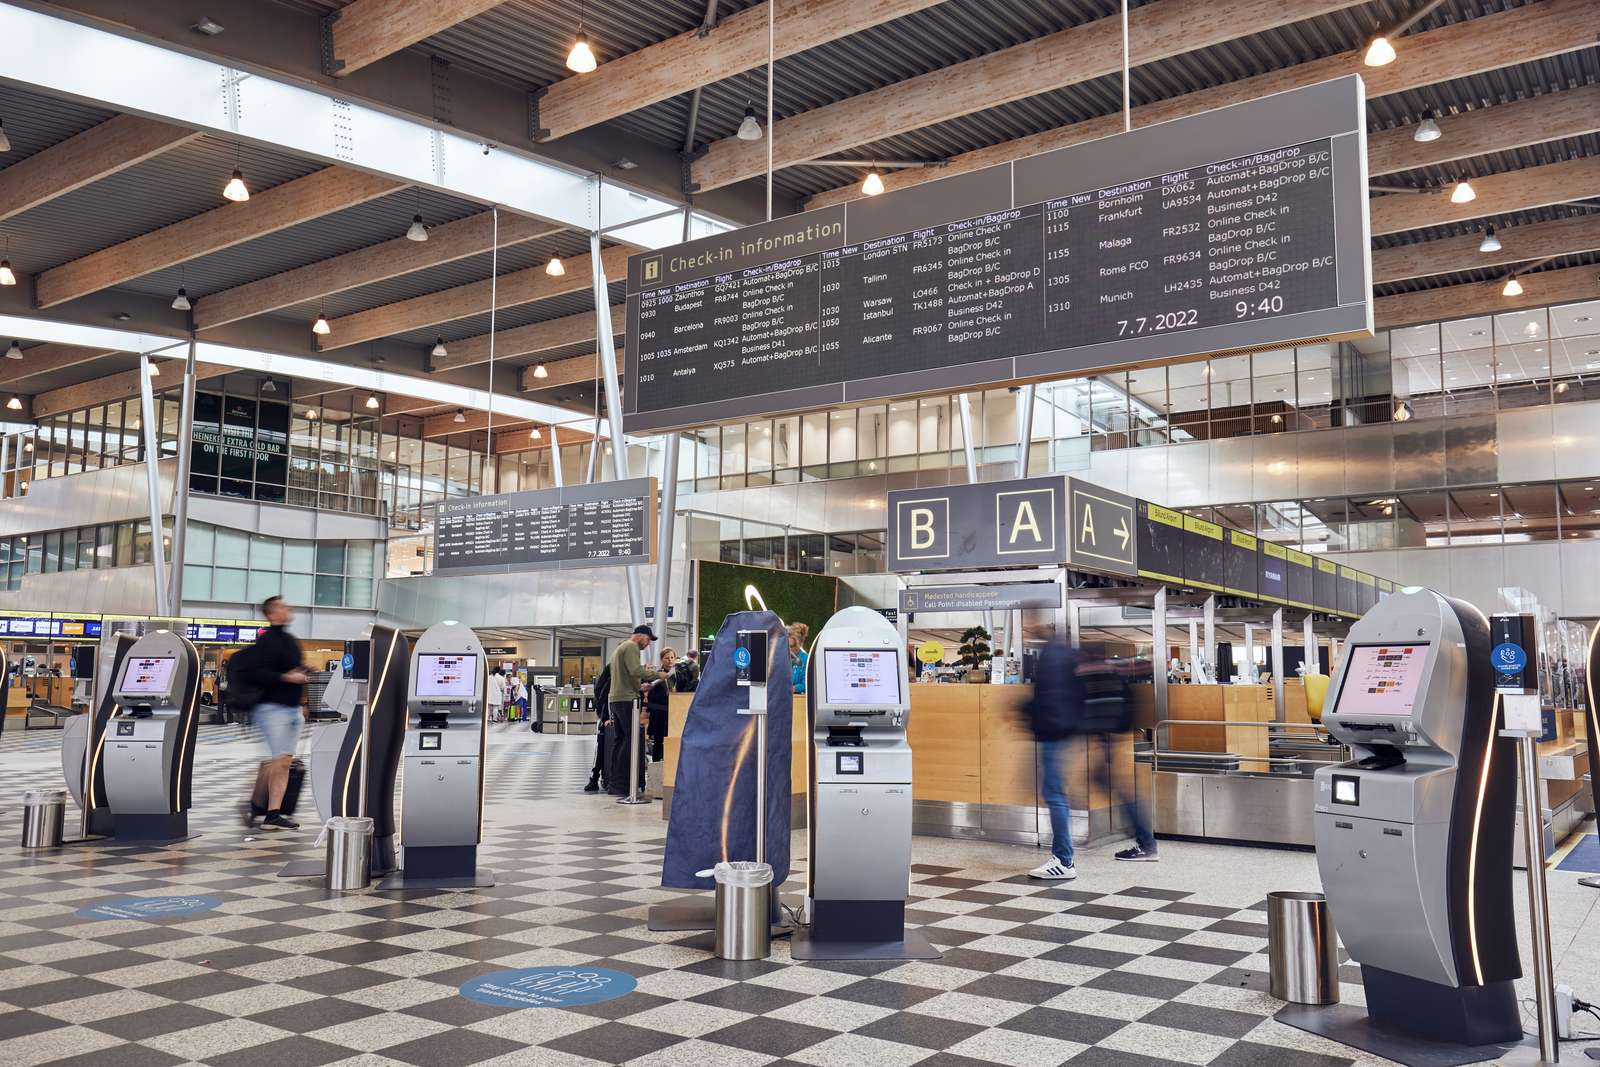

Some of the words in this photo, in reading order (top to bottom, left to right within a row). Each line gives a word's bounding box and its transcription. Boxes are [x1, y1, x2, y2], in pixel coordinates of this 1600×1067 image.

[1046, 199, 1068, 209] Time
[1072, 193, 1091, 204] New
[1098, 180, 1151, 198] Destination
[1162, 172, 1189, 185] Flight
[1206, 147, 1300, 174] Check-in/Bagdrop
[1047, 209, 1069, 220] 1100
[1098, 193, 1143, 209] Bornholm
[1162, 182, 1195, 196] DX062
[1207, 158, 1305, 186] Automat+BagDrop
[1309, 152, 1329, 165] B/C
[1047, 223, 1069, 234] 1115
[1099, 207, 1143, 223] Frankfurt
[1162, 194, 1201, 209] UA9534
[1207, 172, 1306, 200] Automat+BagDrop
[1310, 167, 1330, 179] B/C
[1207, 198, 1252, 214] Business
[1256, 192, 1278, 205] D42
[670, 248, 733, 272] Check-in
[741, 221, 841, 256] information
[822, 250, 839, 259] Time
[842, 246, 858, 255] New
[864, 235, 905, 250] Destination
[913, 229, 934, 240] Flight
[948, 210, 1020, 232] Check-in/Bagdrop
[823, 260, 840, 269] 1015
[864, 248, 890, 260] London
[893, 244, 908, 254] STN
[913, 237, 943, 249] FR5173
[948, 231, 973, 242] Online
[976, 226, 1000, 236] Check
[948, 240, 982, 254] BagDrop
[985, 237, 1000, 248] B/C
[1048, 249, 1070, 260] 1155
[1099, 236, 1132, 251] Malaga
[1163, 223, 1200, 237] FR2532
[1208, 215, 1241, 228] Online
[1244, 209, 1277, 222] Check
[1280, 205, 1289, 215] in
[1208, 227, 1254, 243] BagDrop
[1256, 222, 1276, 234] B/C
[675, 279, 709, 292] Destination
[715, 274, 732, 283] Flight
[743, 258, 802, 277] Check-in/Bagdrop
[822, 283, 840, 293] 1030
[864, 273, 887, 284] Tallinn
[913, 261, 943, 274] FR6345
[948, 256, 973, 267] Online
[976, 251, 1001, 261] Check
[948, 266, 982, 279] BagDrop
[985, 262, 1000, 273] B/C
[1048, 274, 1070, 286] 1305
[1100, 265, 1126, 276] Rome
[1129, 260, 1149, 272] FCO
[1163, 251, 1201, 265] FR9634
[1209, 243, 1241, 257] Online
[1245, 238, 1278, 251] Check
[1281, 234, 1290, 243] in
[1209, 256, 1254, 272] BagDrop
[1257, 251, 1277, 264] B/C
[641, 300, 656, 308] 0925
[743, 267, 804, 286] Automat+BagDrop
[806, 263, 819, 273] B/C
[641, 310, 656, 319] 0930
[675, 300, 703, 312] Budapest
[714, 292, 739, 303] FR8744
[743, 288, 763, 298] Online
[765, 284, 786, 292] Check
[822, 307, 840, 316] 1030
[864, 297, 892, 308] Warsaw
[913, 287, 938, 298] LO466
[948, 281, 973, 292] Check
[995, 271, 1031, 284] BagDrop
[1048, 301, 1070, 313] 1310
[1100, 291, 1133, 304] Munich
[1164, 279, 1202, 293] LH2435
[1209, 262, 1309, 286] Automat+BagDrop
[1312, 255, 1333, 267] B/C
[1210, 285, 1255, 299] Business
[1259, 280, 1280, 292] D42
[641, 331, 655, 340] 0940
[674, 322, 704, 333] Barcelona
[714, 315, 738, 325] FR9003
[743, 310, 763, 320] Online
[765, 306, 785, 316] Check
[822, 318, 840, 328] 1050
[864, 308, 894, 320] Istanbul
[913, 299, 942, 311] TK1488
[948, 286, 1024, 305] Automat+BagDrop
[948, 305, 983, 317] Business
[986, 301, 1003, 311] D42
[1118, 309, 1198, 336] 7.7.2022
[1236, 295, 1283, 318] 9:40
[640, 352, 654, 361] 1005
[657, 350, 672, 358] 1035
[674, 343, 708, 355] Amsterdam
[742, 326, 803, 343] Automat+BagDrop
[805, 322, 818, 331] B/C
[742, 345, 770, 354] Business
[772, 340, 785, 348] D41
[822, 342, 839, 351] 1055
[863, 332, 892, 344] Alicante
[913, 324, 942, 336] FR9067
[948, 319, 973, 329] Online
[976, 314, 1001, 325] Check
[1003, 312, 1012, 320] in
[948, 330, 982, 343] BagDrop
[985, 327, 1000, 337] B/C
[640, 375, 654, 383] 1010
[673, 368, 696, 377] Antalya
[713, 360, 735, 370] XQ575
[742, 348, 803, 365] Automat+BagDrop
[805, 345, 817, 354] B/C
[216, 446, 227, 455] TE
[230, 448, 246, 458] FIRST
[227, 437, 247, 448] EXTRA
[250, 442, 265, 451] CLD
[268, 444, 280, 452] BAR
[473, 500, 507, 508] information
[1009, 501, 1042, 544] A
[911, 508, 935, 549] B
[1082, 503, 1096, 545] A
